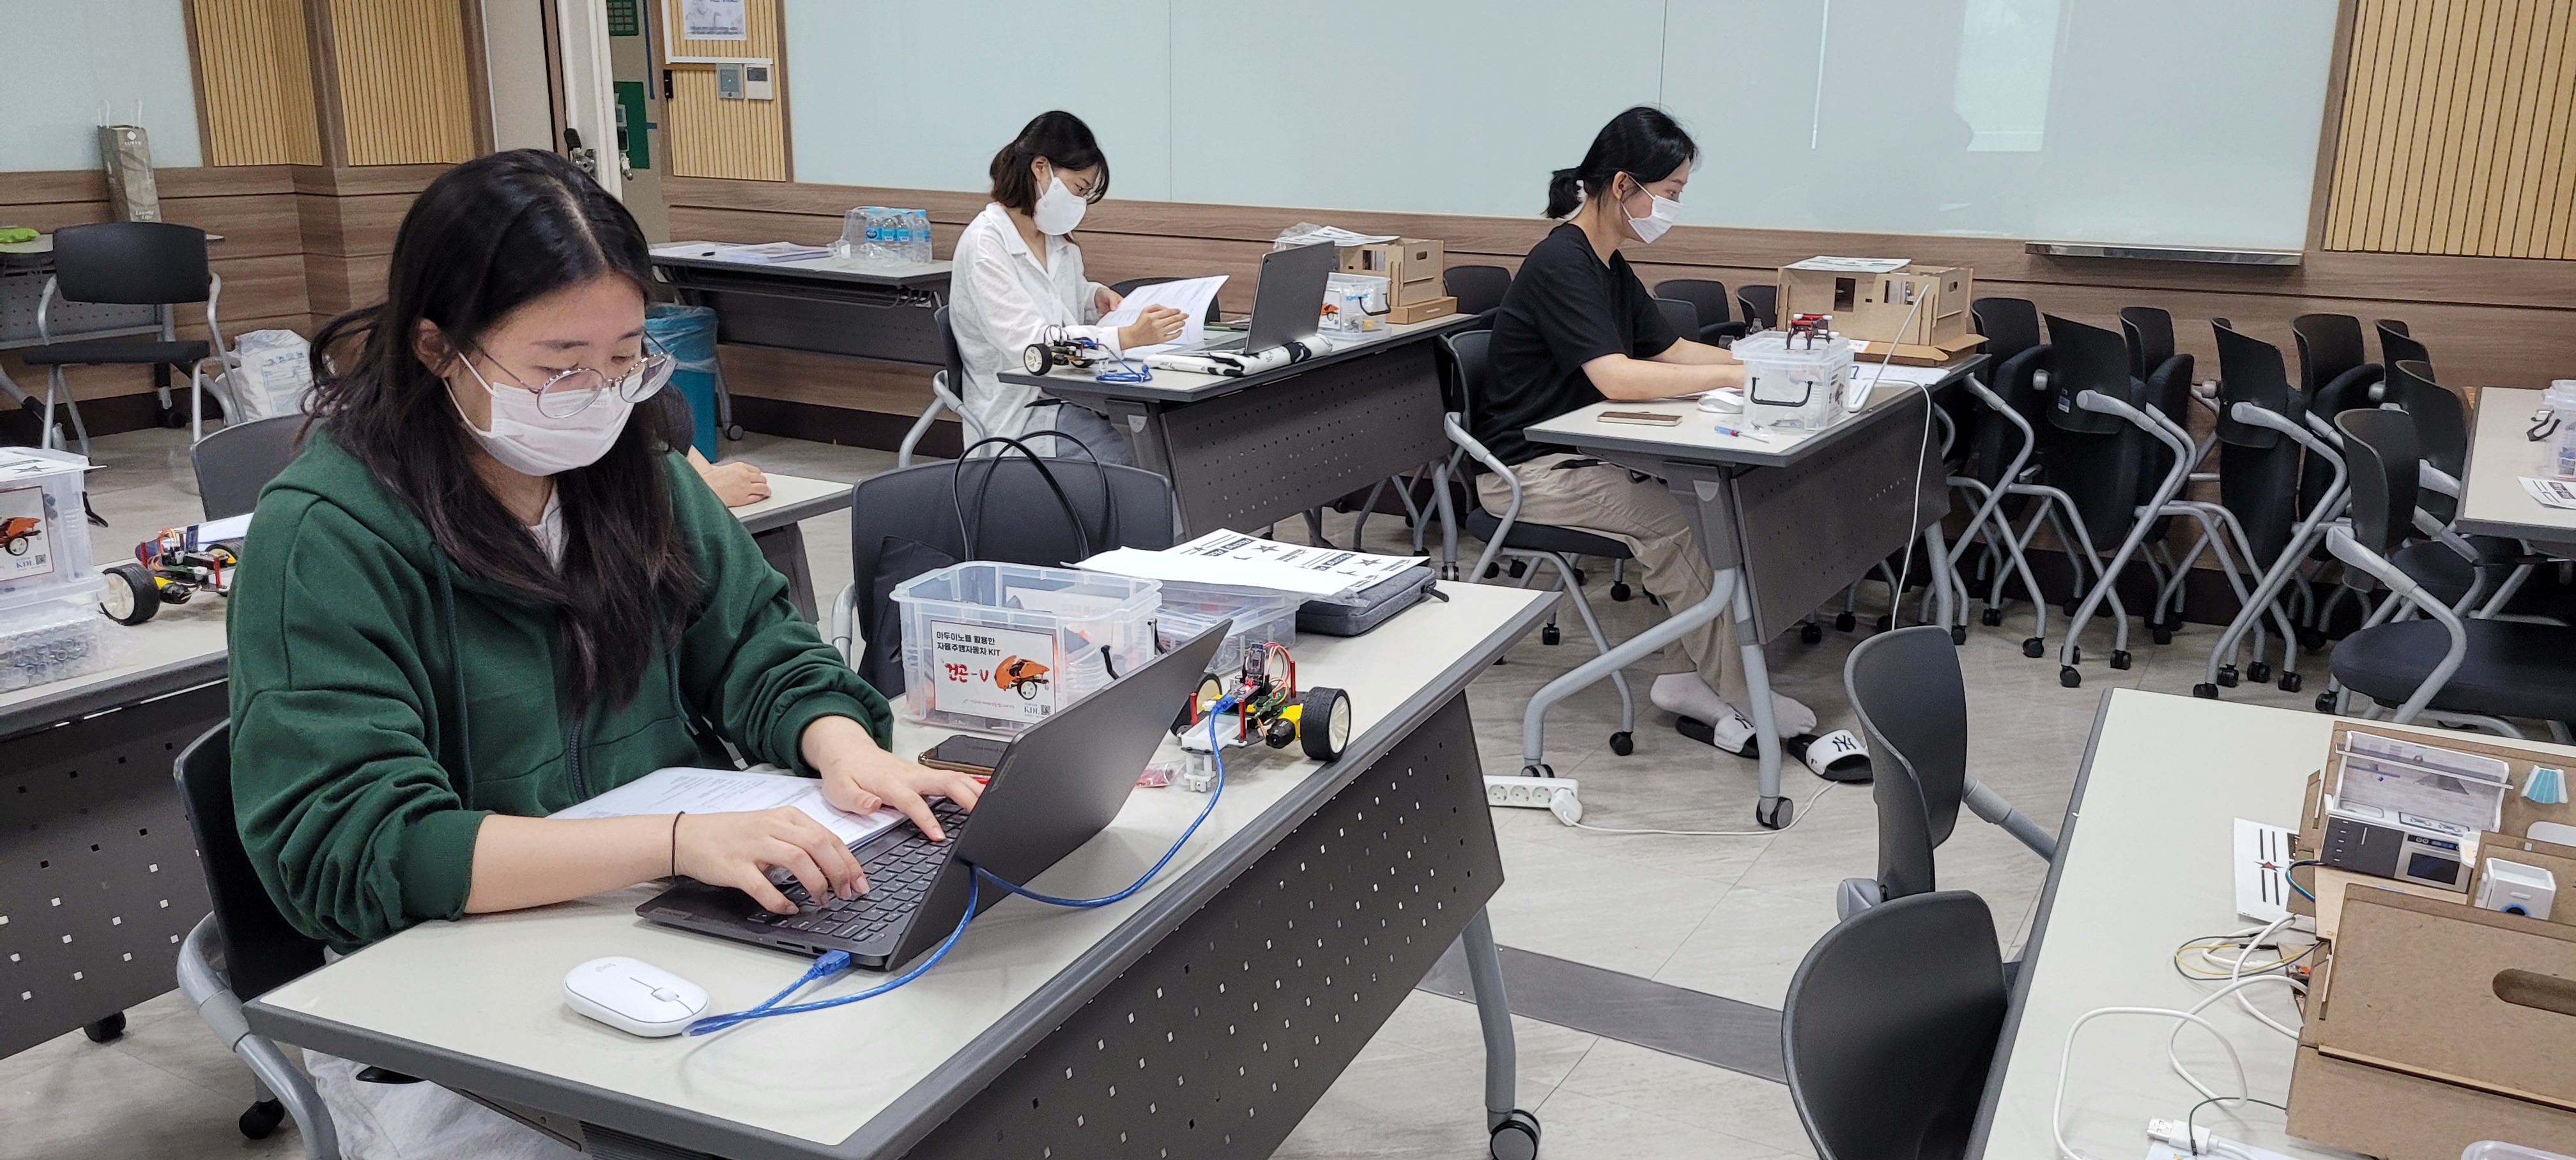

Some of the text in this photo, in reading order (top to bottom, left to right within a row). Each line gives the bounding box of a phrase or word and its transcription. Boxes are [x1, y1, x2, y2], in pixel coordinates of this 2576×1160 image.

[937, 631, 995, 645] 아두이노를 활용한
[937, 642, 986, 655] 자율주행자동차
